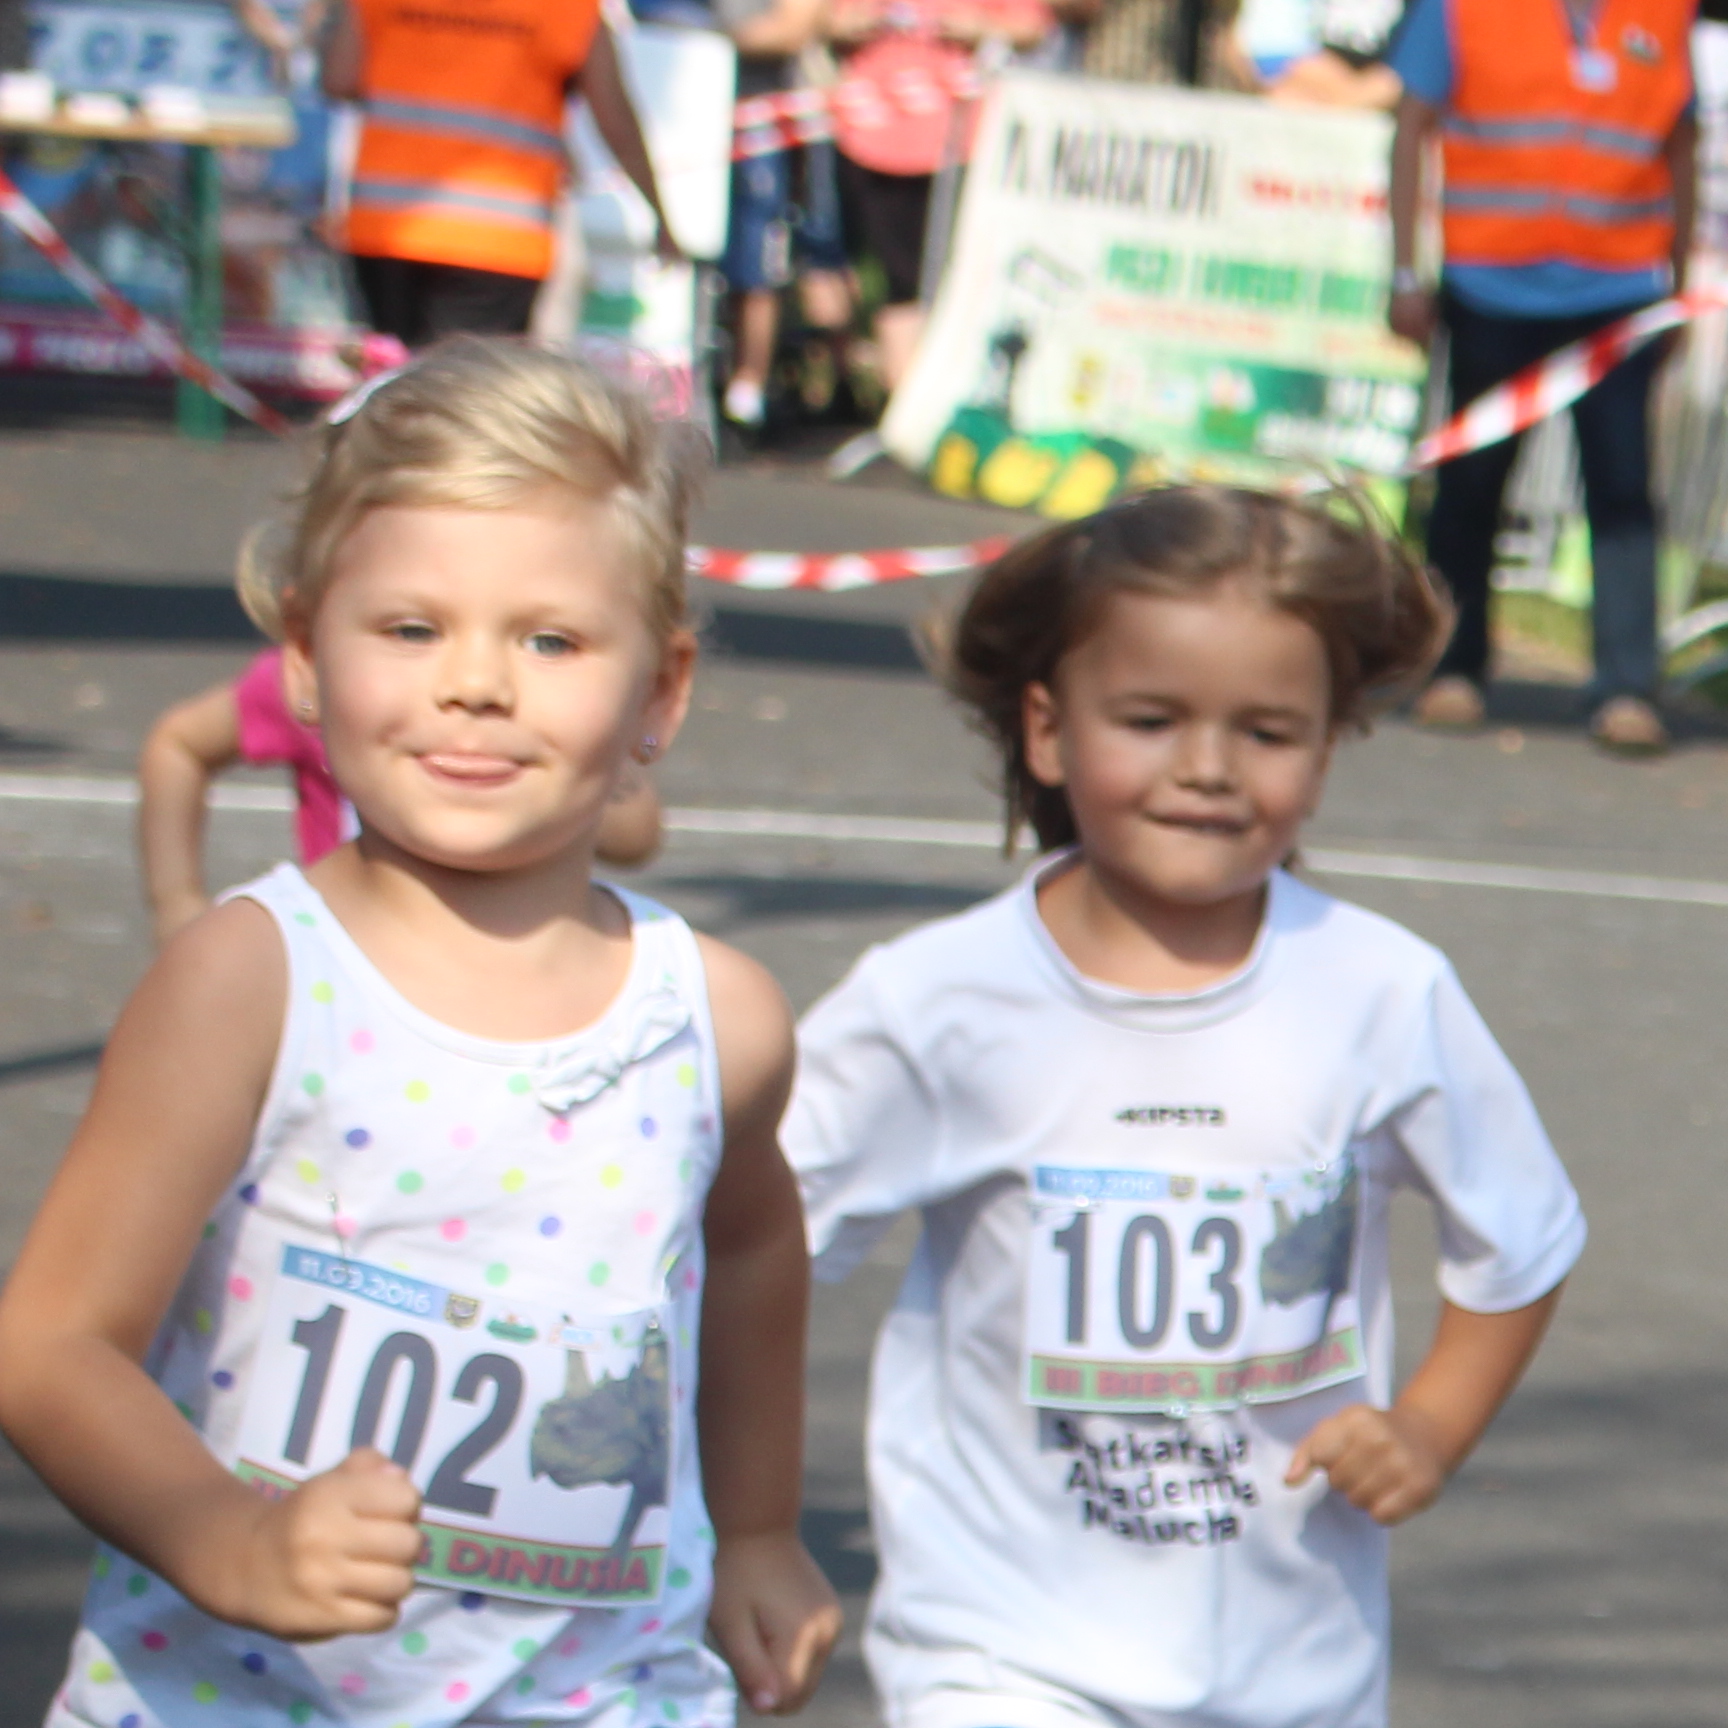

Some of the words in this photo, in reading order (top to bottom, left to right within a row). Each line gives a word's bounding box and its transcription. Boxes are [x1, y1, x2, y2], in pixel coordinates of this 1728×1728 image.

[1053, 1211, 1242, 1351] 103
[284, 1303, 526, 1519] 102
[446, 1538, 650, 1593] DINUSIA
